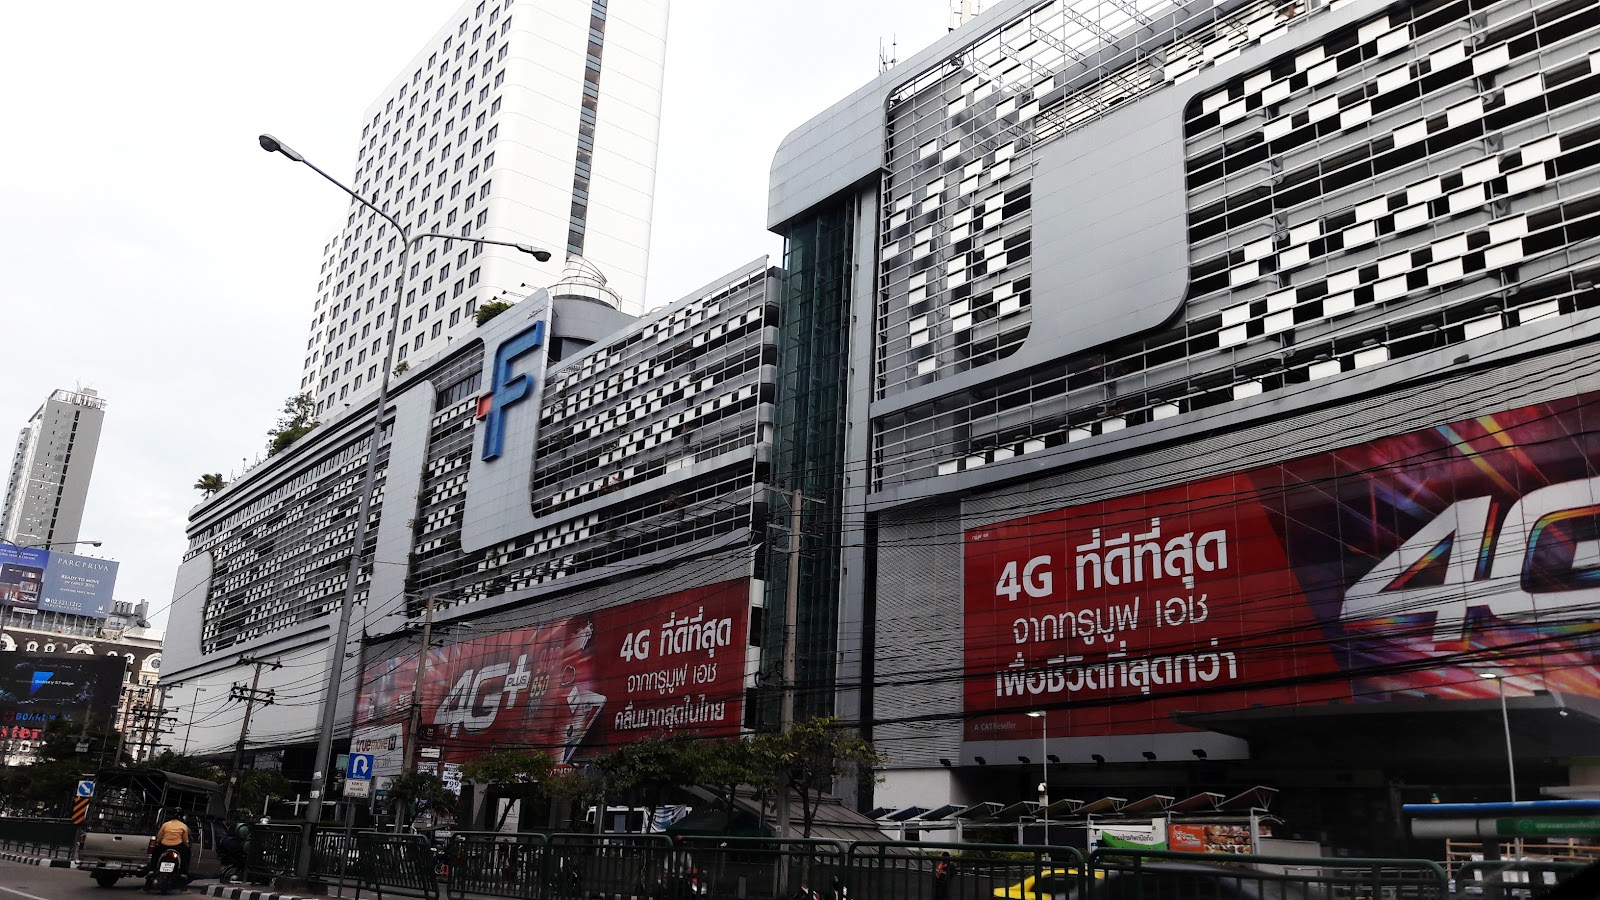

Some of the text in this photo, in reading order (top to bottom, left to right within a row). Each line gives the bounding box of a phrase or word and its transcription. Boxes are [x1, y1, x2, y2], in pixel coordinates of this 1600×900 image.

[995, 516, 1228, 602] 4G ที่ดีที่สุด
[620, 606, 732, 662] 4G ที่ดีที่สุด
[1012, 594, 1209, 645] จากทรูมูฟ เอช
[506, 675, 528, 687] PLUS
[628, 662, 718, 694] จากทรูมูฟ เอช
[996, 637, 1238, 696] เพื่อชีวิตที่สุดกว่า
[614, 694, 726, 731] คลื่นมากสุดในไทย
[980, 722, 993, 731] CAT
[993, 721, 1016, 730] Reseller
